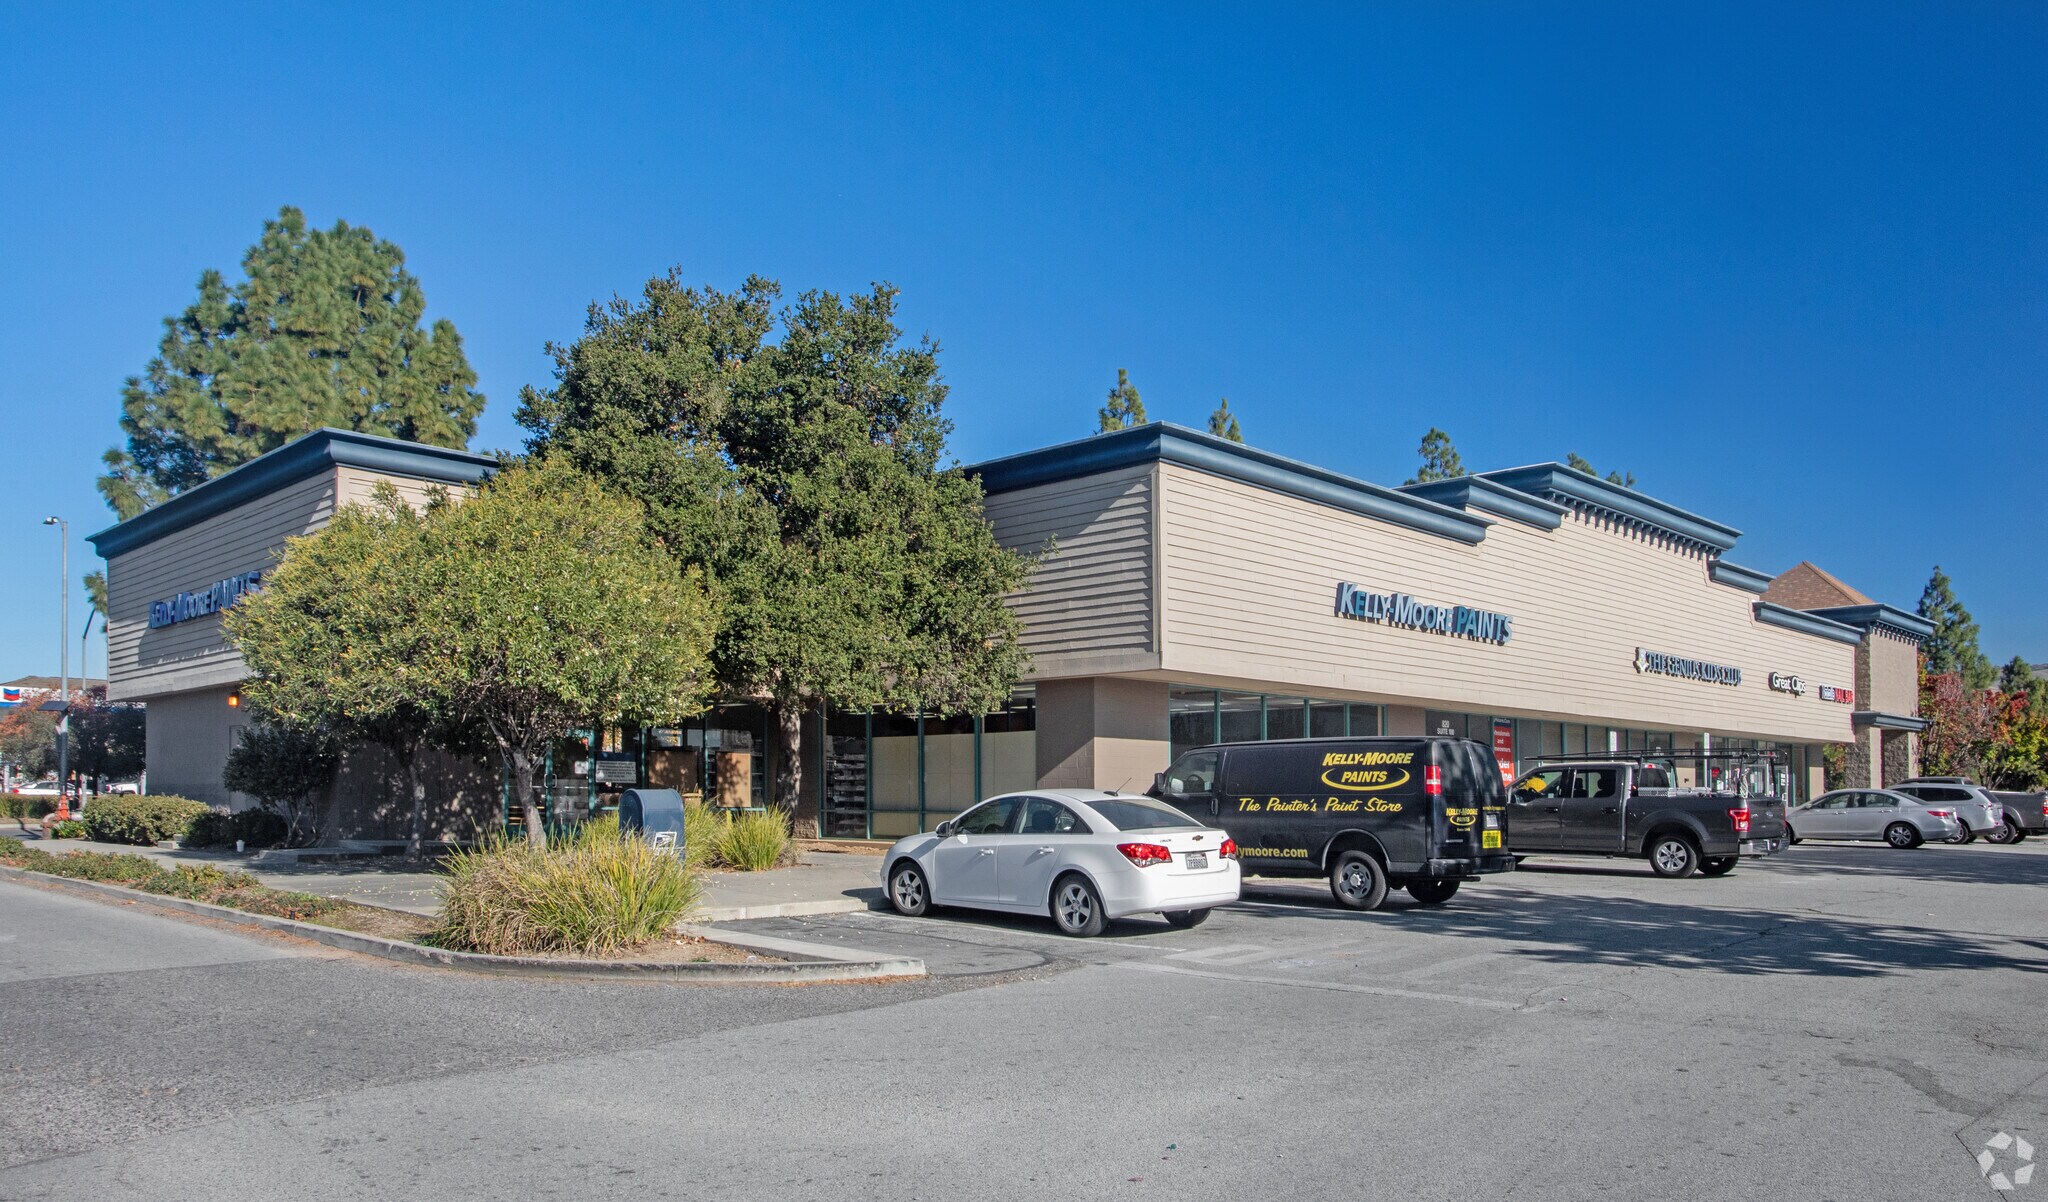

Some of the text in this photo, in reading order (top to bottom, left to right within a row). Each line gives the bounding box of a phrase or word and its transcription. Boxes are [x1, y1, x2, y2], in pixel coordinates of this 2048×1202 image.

[1334, 582, 1513, 643] KELLY-MOORE PAINTS
[1647, 651, 1667, 672] THE
[1667, 655, 1701, 678] GENIUS
[1770, 672, 1791, 690] Great
[1322, 752, 1414, 766] KELLY-MOORE
[1499, 758, 1510, 769] der
[1341, 771, 1388, 783] PAINTS
[1502, 770, 1513, 782] ine
[1238, 797, 1403, 812] The Painter's Paint Store
[1445, 807, 1478, 816] KELLY-MOORE
[1235, 844, 1308, 859] lymoore.com
